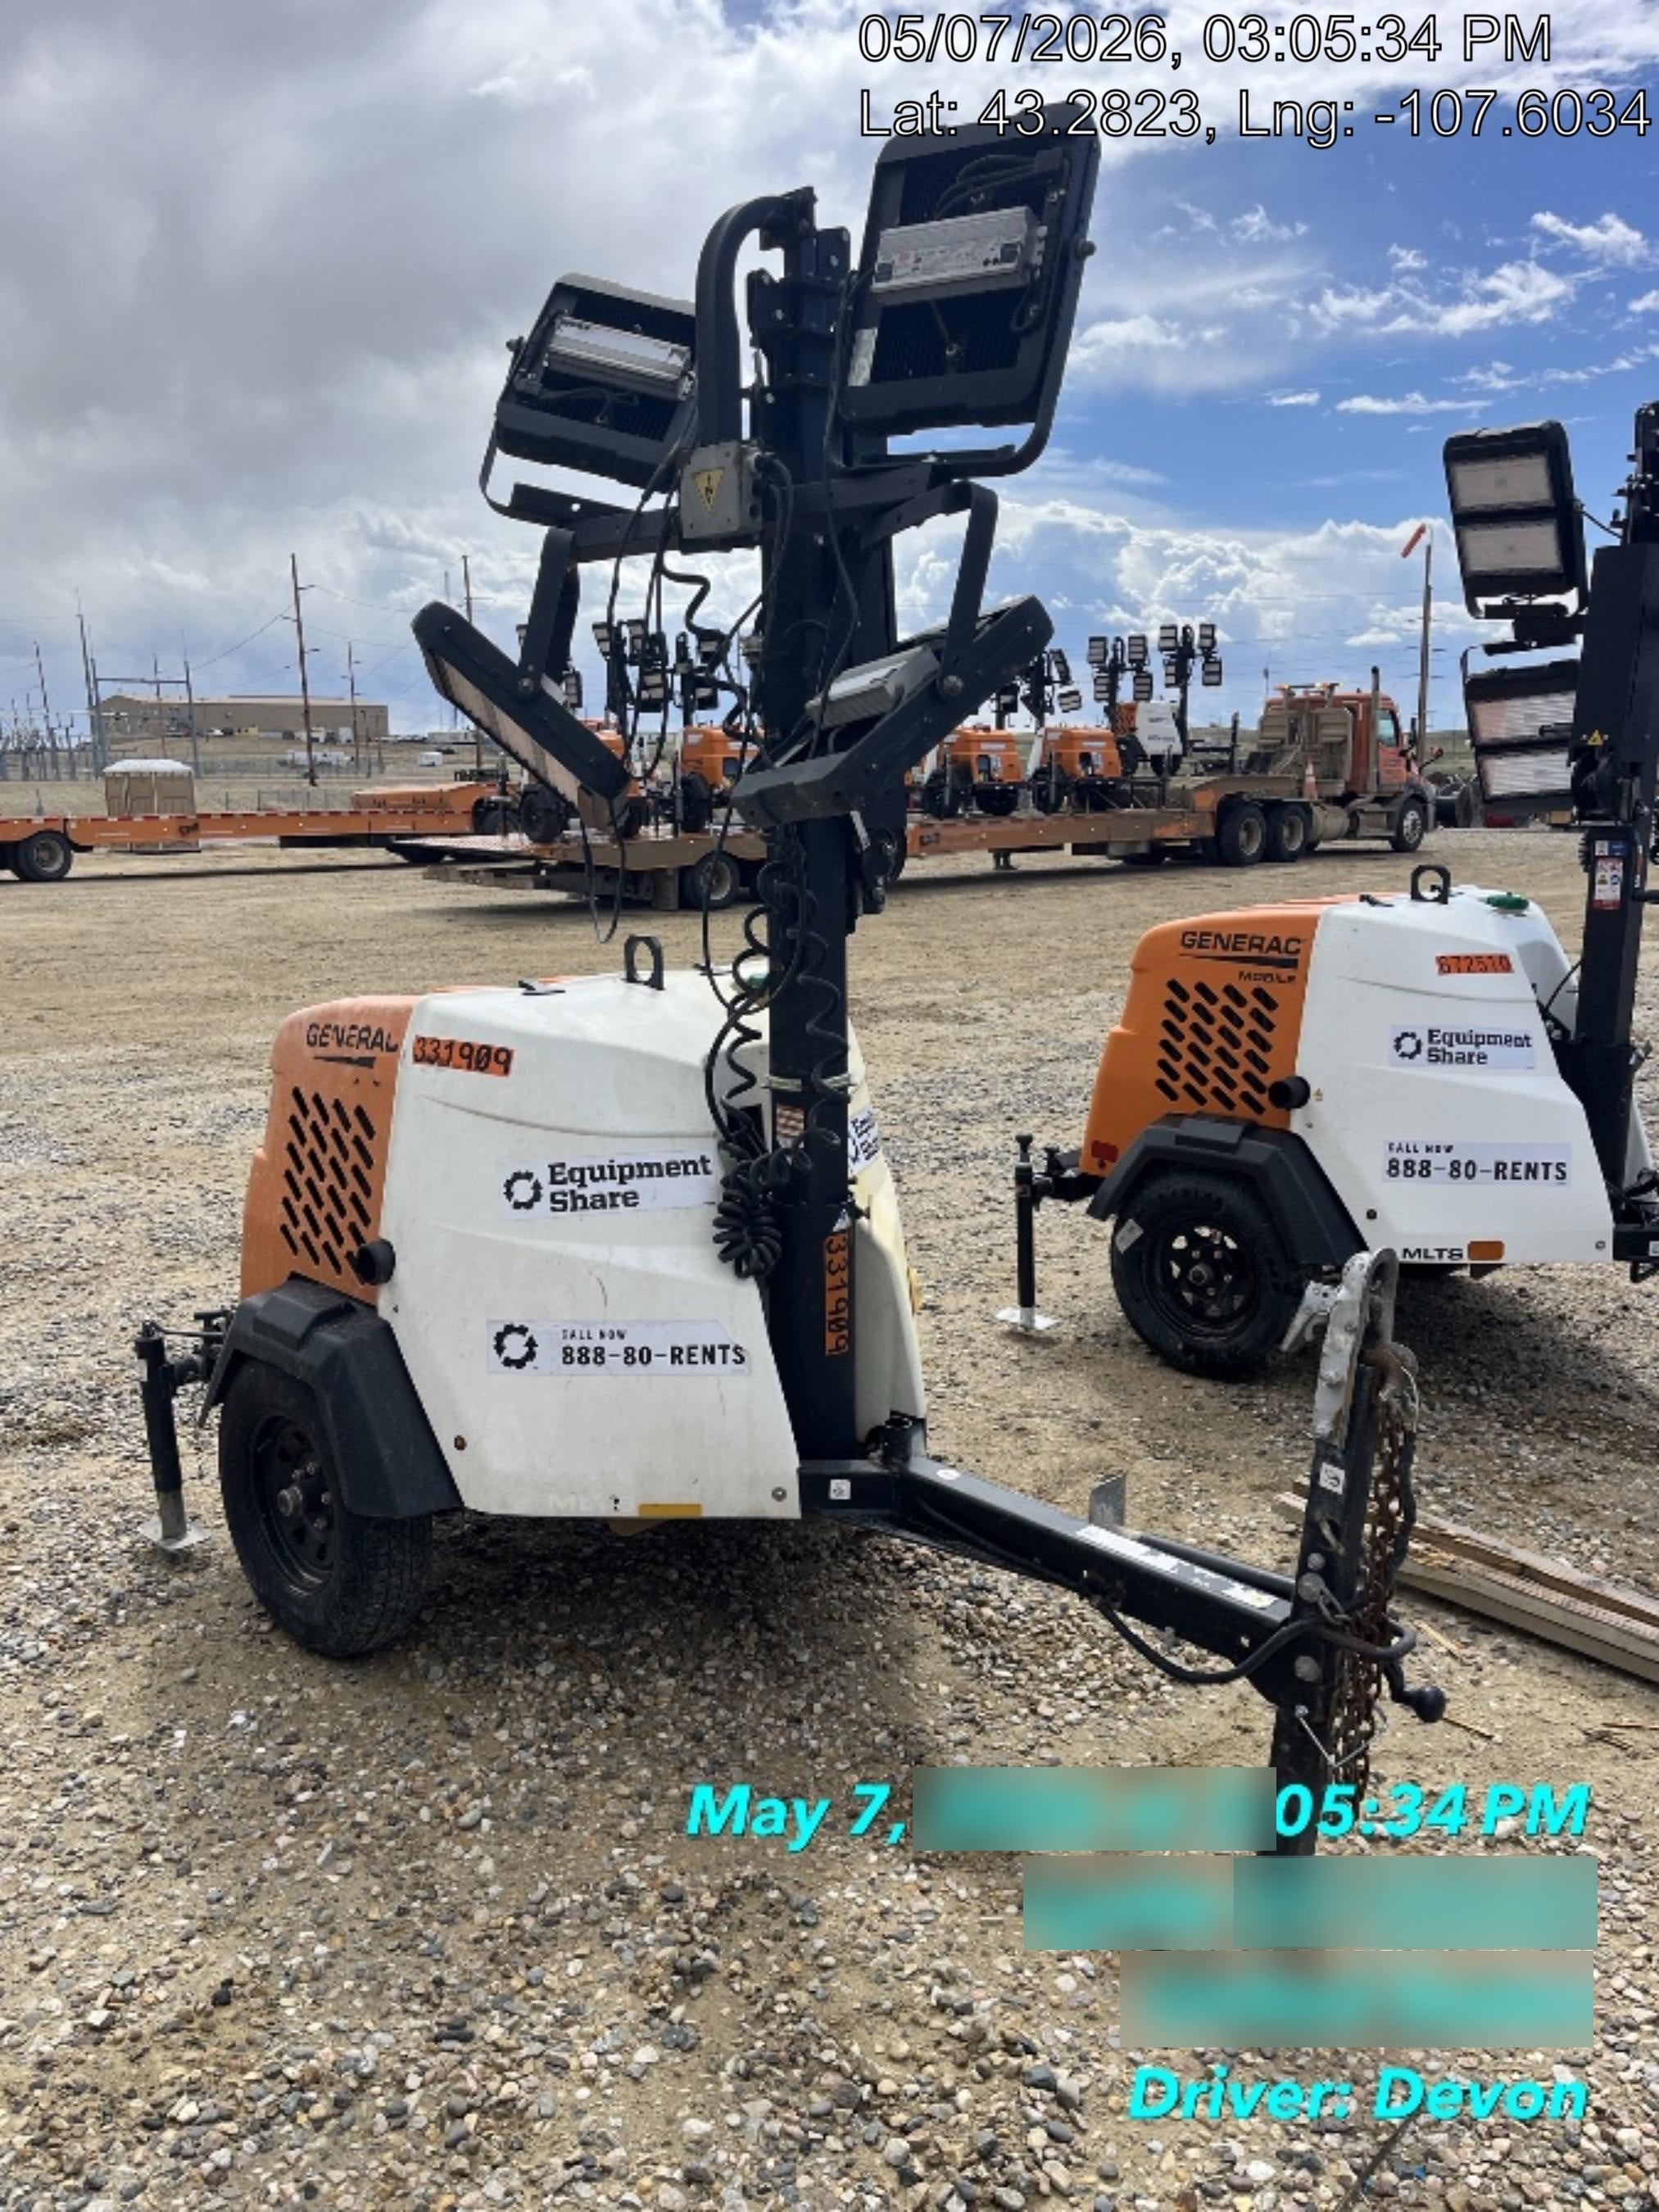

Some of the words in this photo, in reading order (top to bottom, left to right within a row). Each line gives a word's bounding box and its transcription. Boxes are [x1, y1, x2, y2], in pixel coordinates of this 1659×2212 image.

[1180, 930, 1301, 954] GENERAC
[1427, 1028, 1533, 1049] Equipment
[413, 1036, 514, 1076] 331909
[1427, 1047, 1489, 1065] Share
[547, 1154, 713, 1188] Equipment
[1386, 1158, 1568, 1181] 888-80-RENTS
[549, 1189, 640, 1213] Share
[1402, 1248, 1464, 1261] MLTS
[561, 1344, 747, 1367] 888-80-RENTS
